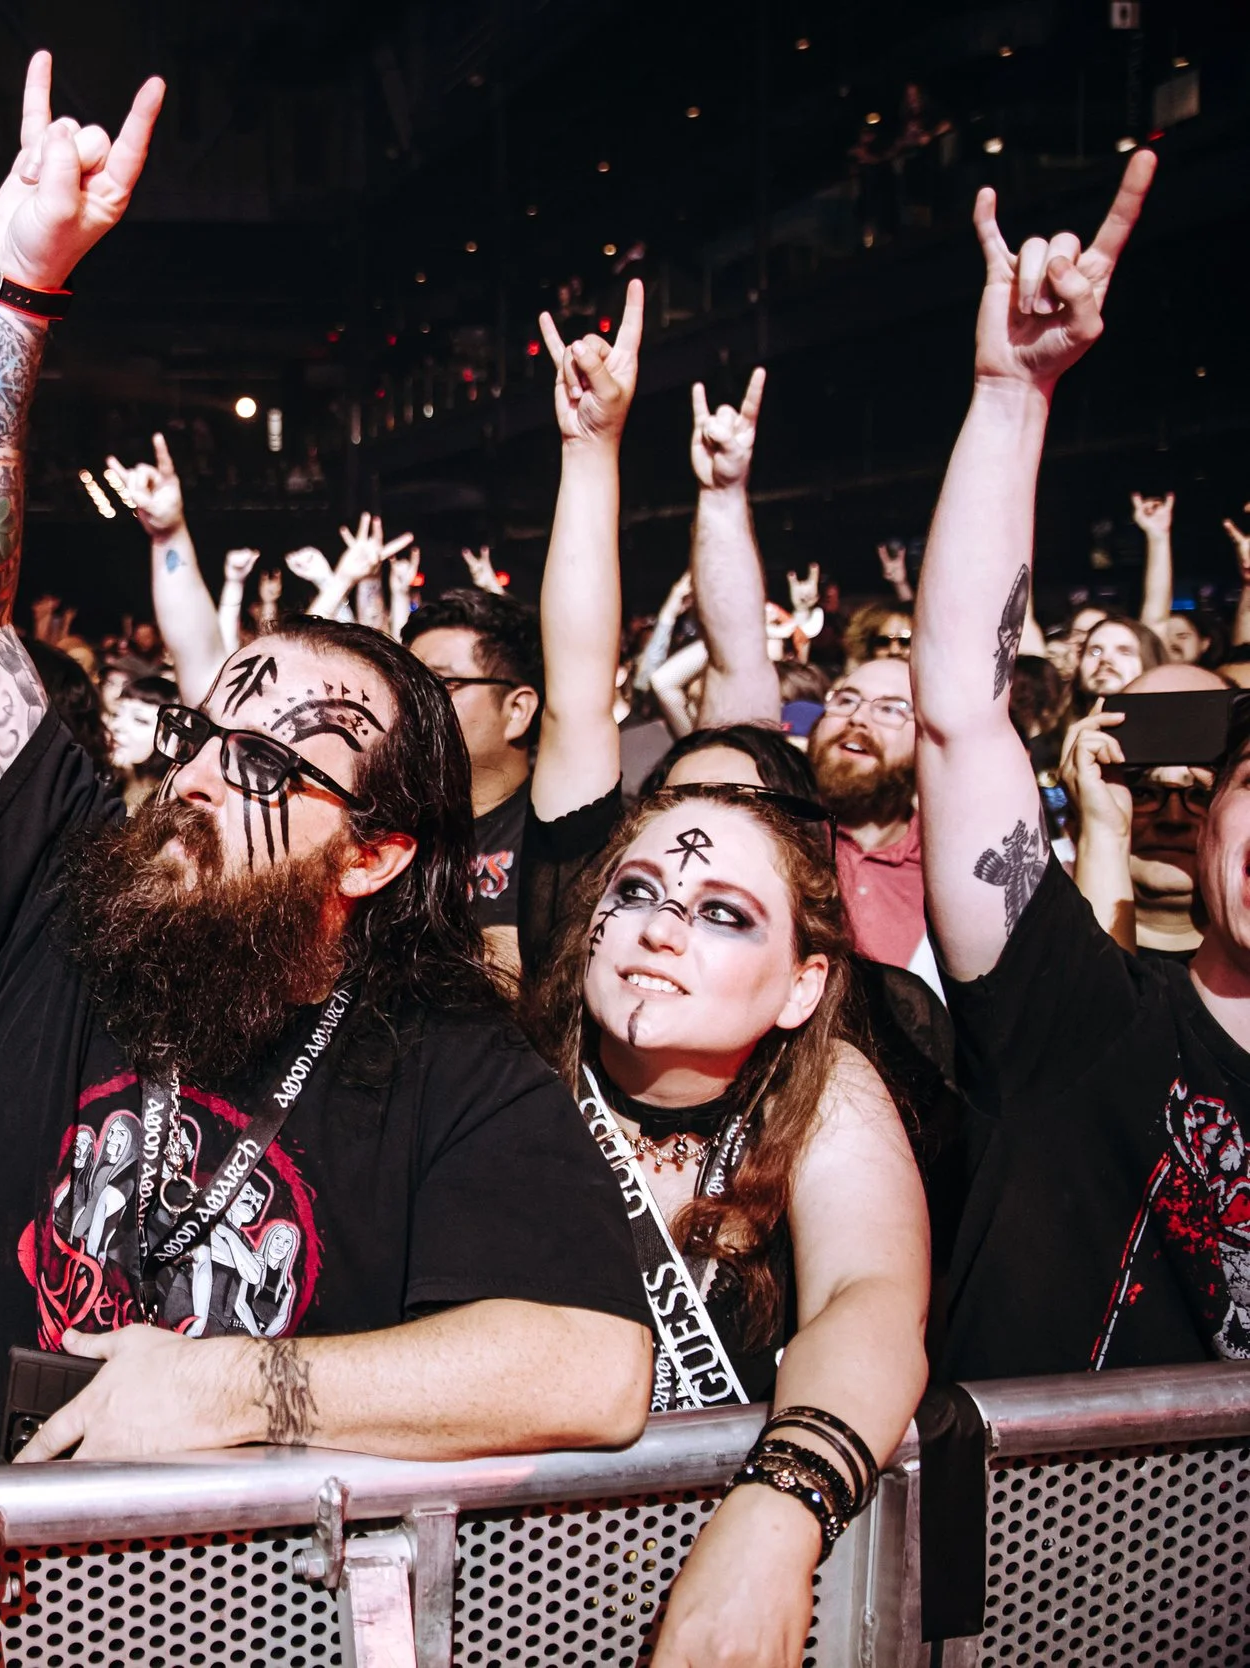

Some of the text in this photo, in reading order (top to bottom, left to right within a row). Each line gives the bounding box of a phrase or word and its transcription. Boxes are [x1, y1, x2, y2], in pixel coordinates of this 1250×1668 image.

[143, 1098, 165, 1160] AMON
[195, 1138, 261, 1224] AMARTH
[273, 1056, 313, 1109] AMON
[304, 989, 353, 1058] AMARTH
[642, 1261, 734, 1403] GUESS
